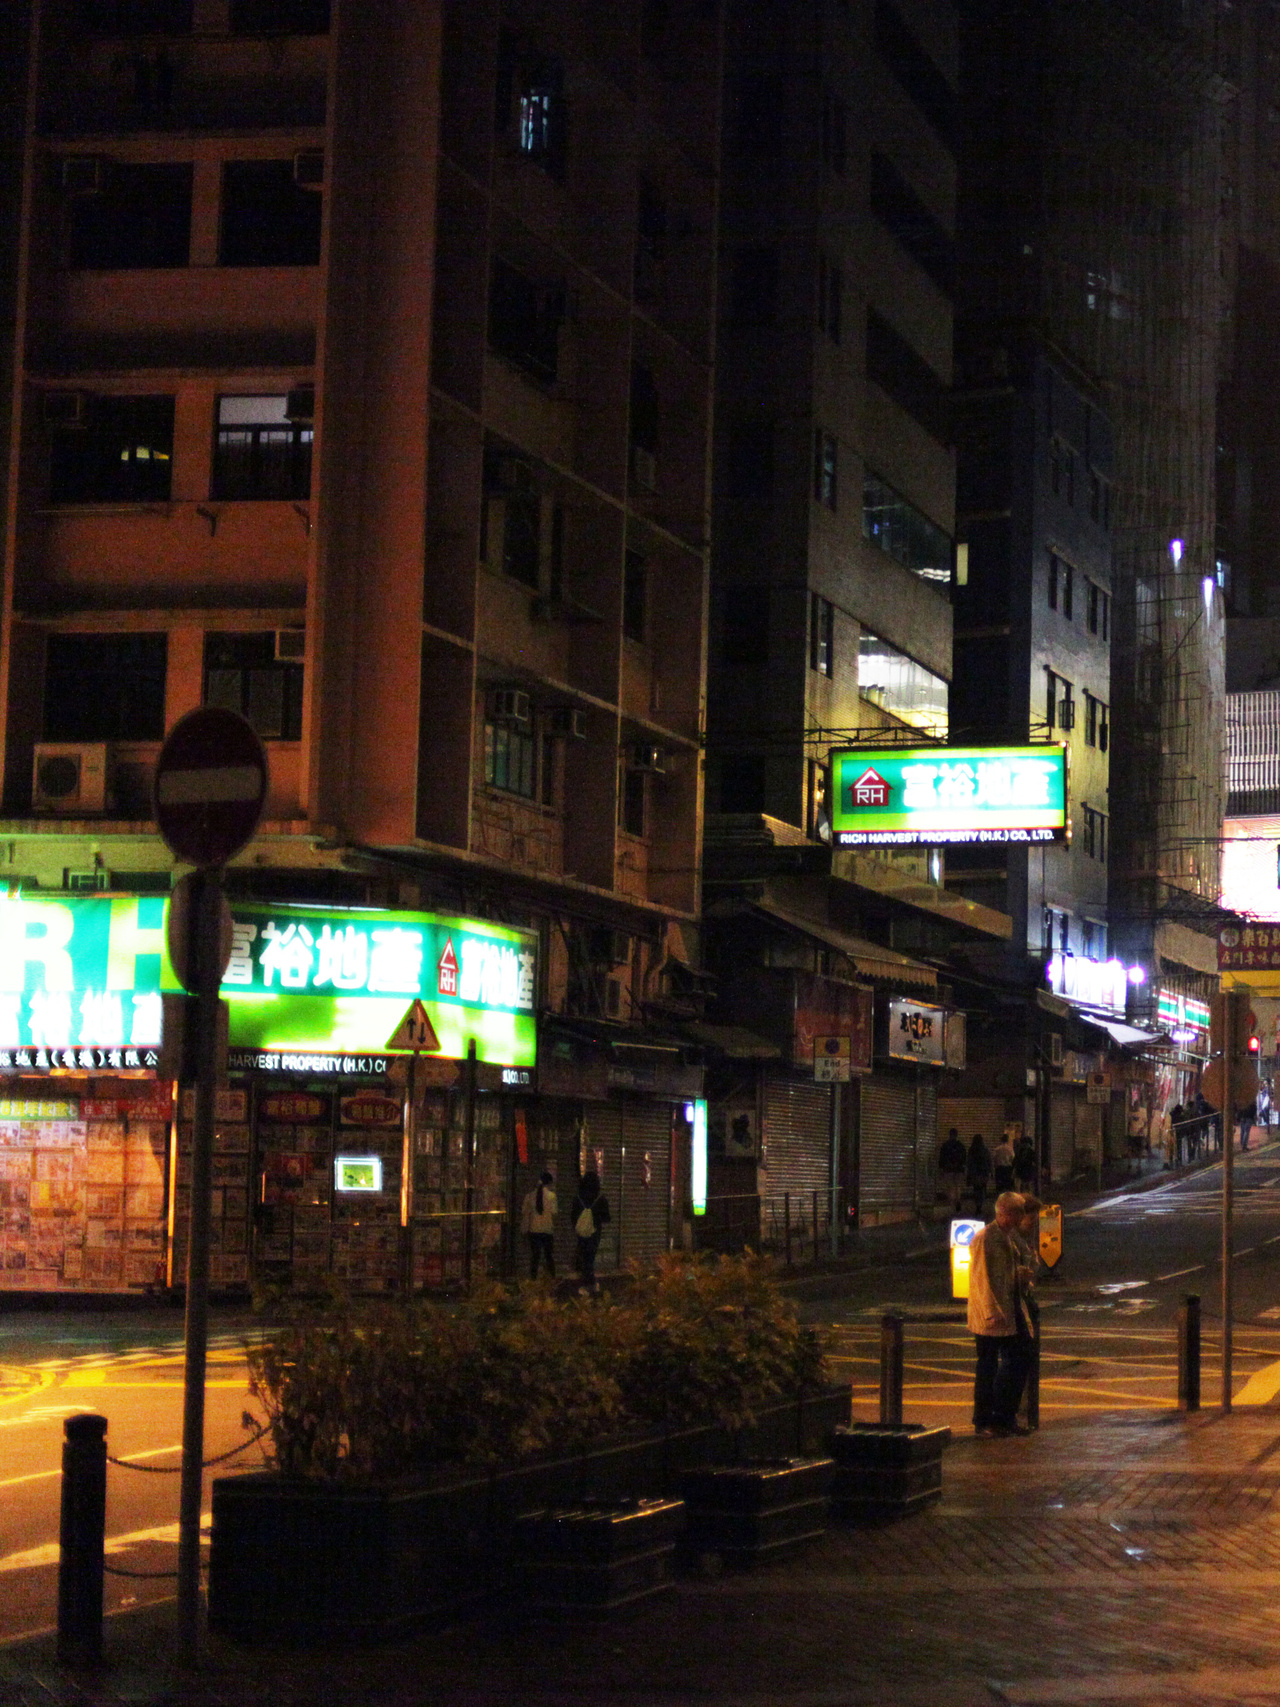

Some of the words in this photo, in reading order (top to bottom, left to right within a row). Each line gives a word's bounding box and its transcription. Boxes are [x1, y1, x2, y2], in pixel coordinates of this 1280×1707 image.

[856, 789, 884, 804] RH
[840, 833, 867, 844] RICH
[868, 832, 919, 844] HARVEST
[920, 831, 979, 843] PROPERTY
[979, 830, 1009, 843] (H.K.)
[1032, 829, 1055, 841] LTD.
[440, 969, 456, 993] RH
[229, 1053, 280, 1070] HARVEST
[281, 1055, 342, 1072] PROPERTY
[343, 1056, 373, 1074] (H.K.)
